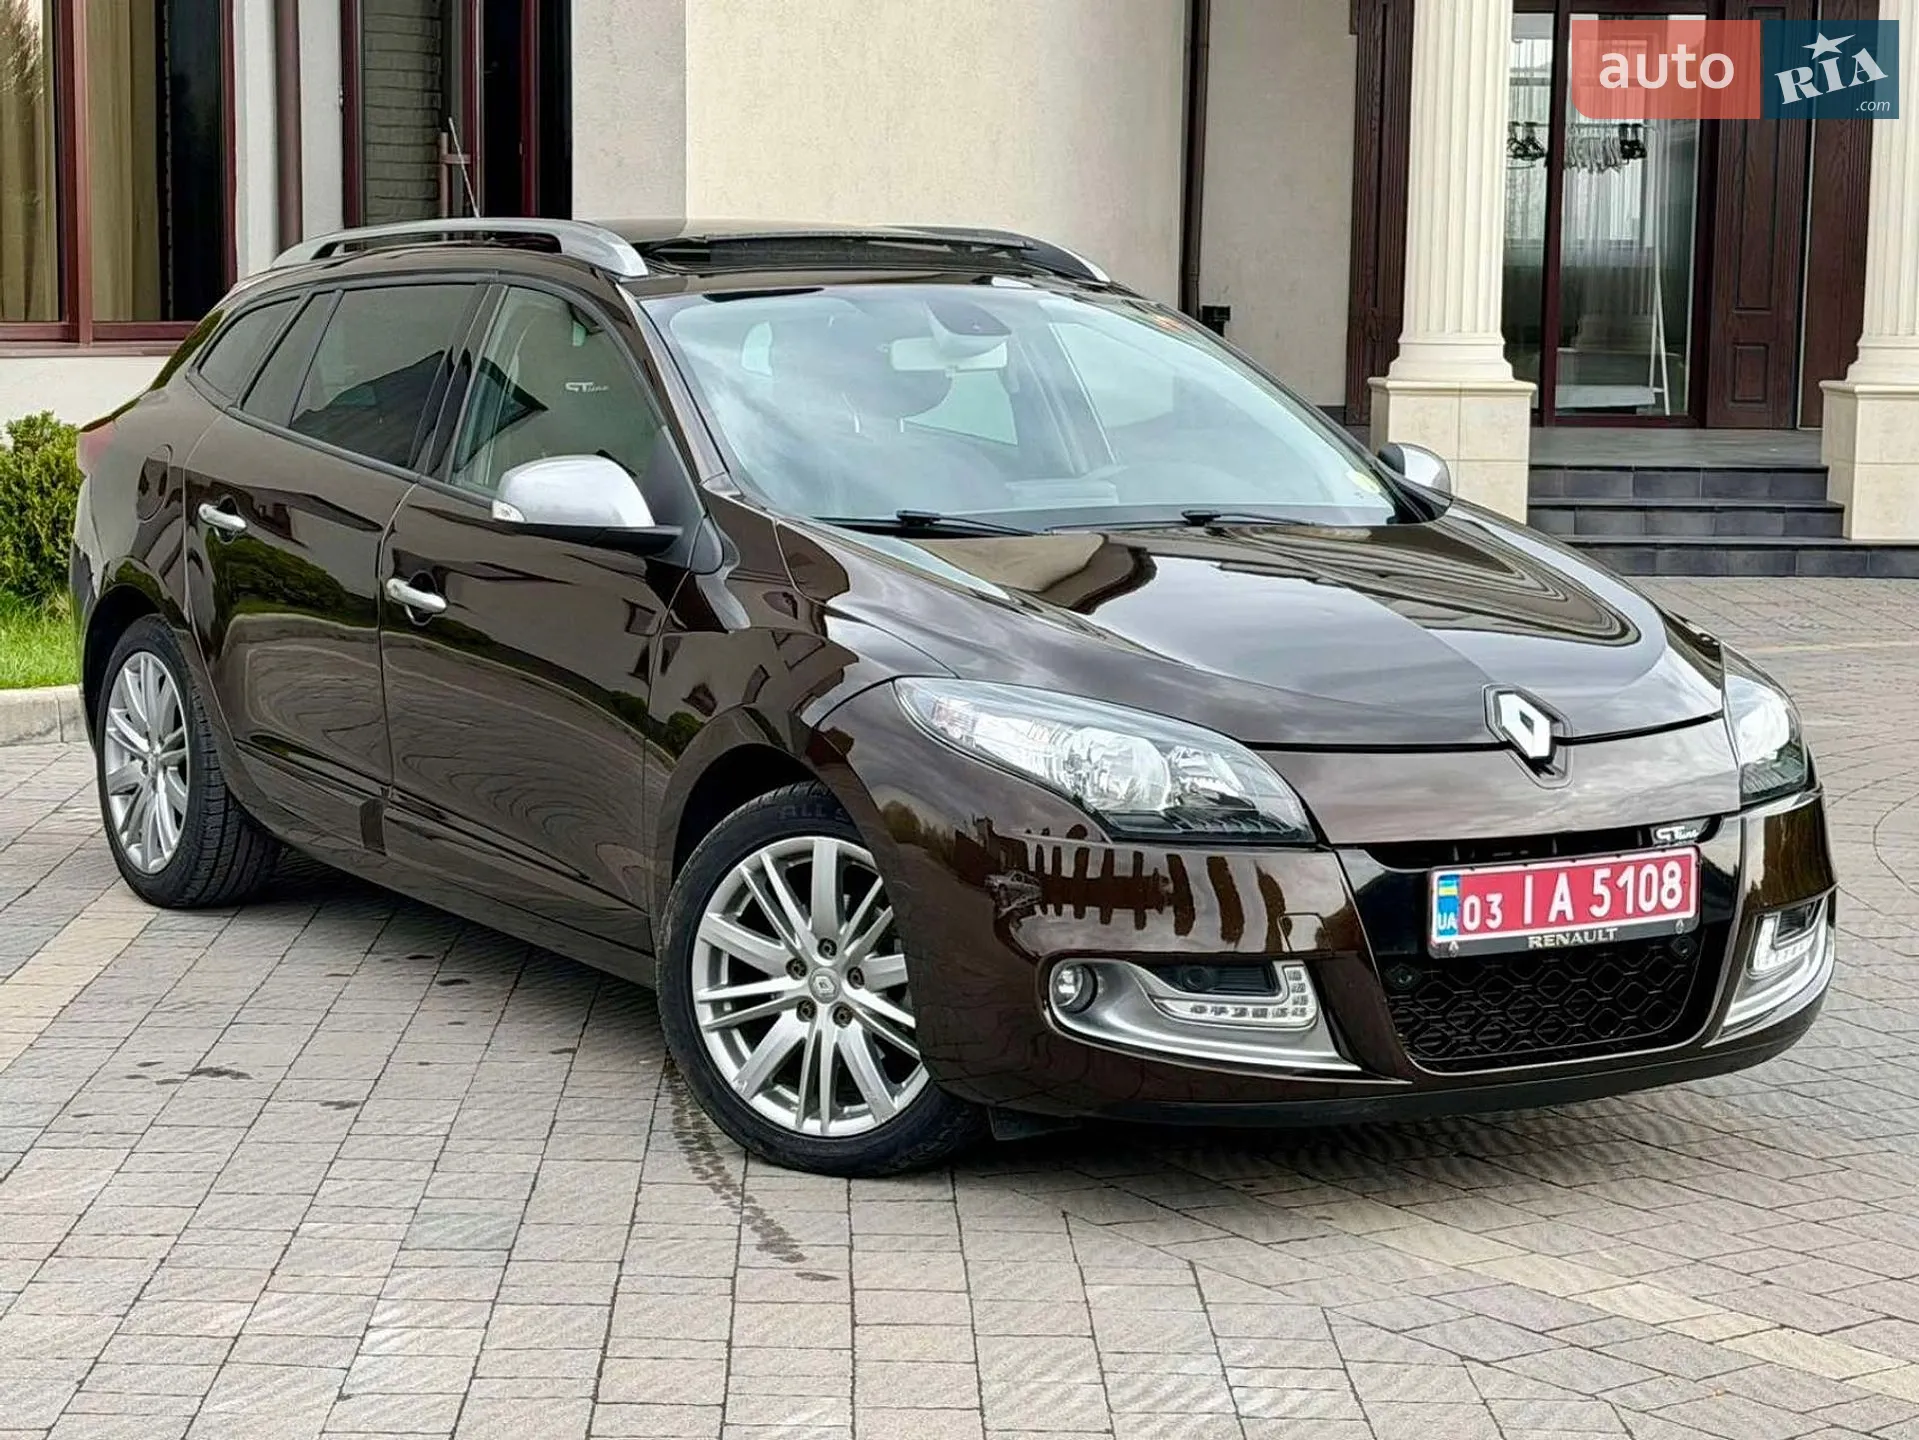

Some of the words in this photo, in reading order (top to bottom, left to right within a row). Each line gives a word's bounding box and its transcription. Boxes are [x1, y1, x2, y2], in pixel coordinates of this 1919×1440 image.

[1462, 892, 1503, 931] 03
[1589, 860, 1683, 918] 5108
[1437, 911, 1459, 930] UA
[1527, 927, 1618, 949] RENAULT
